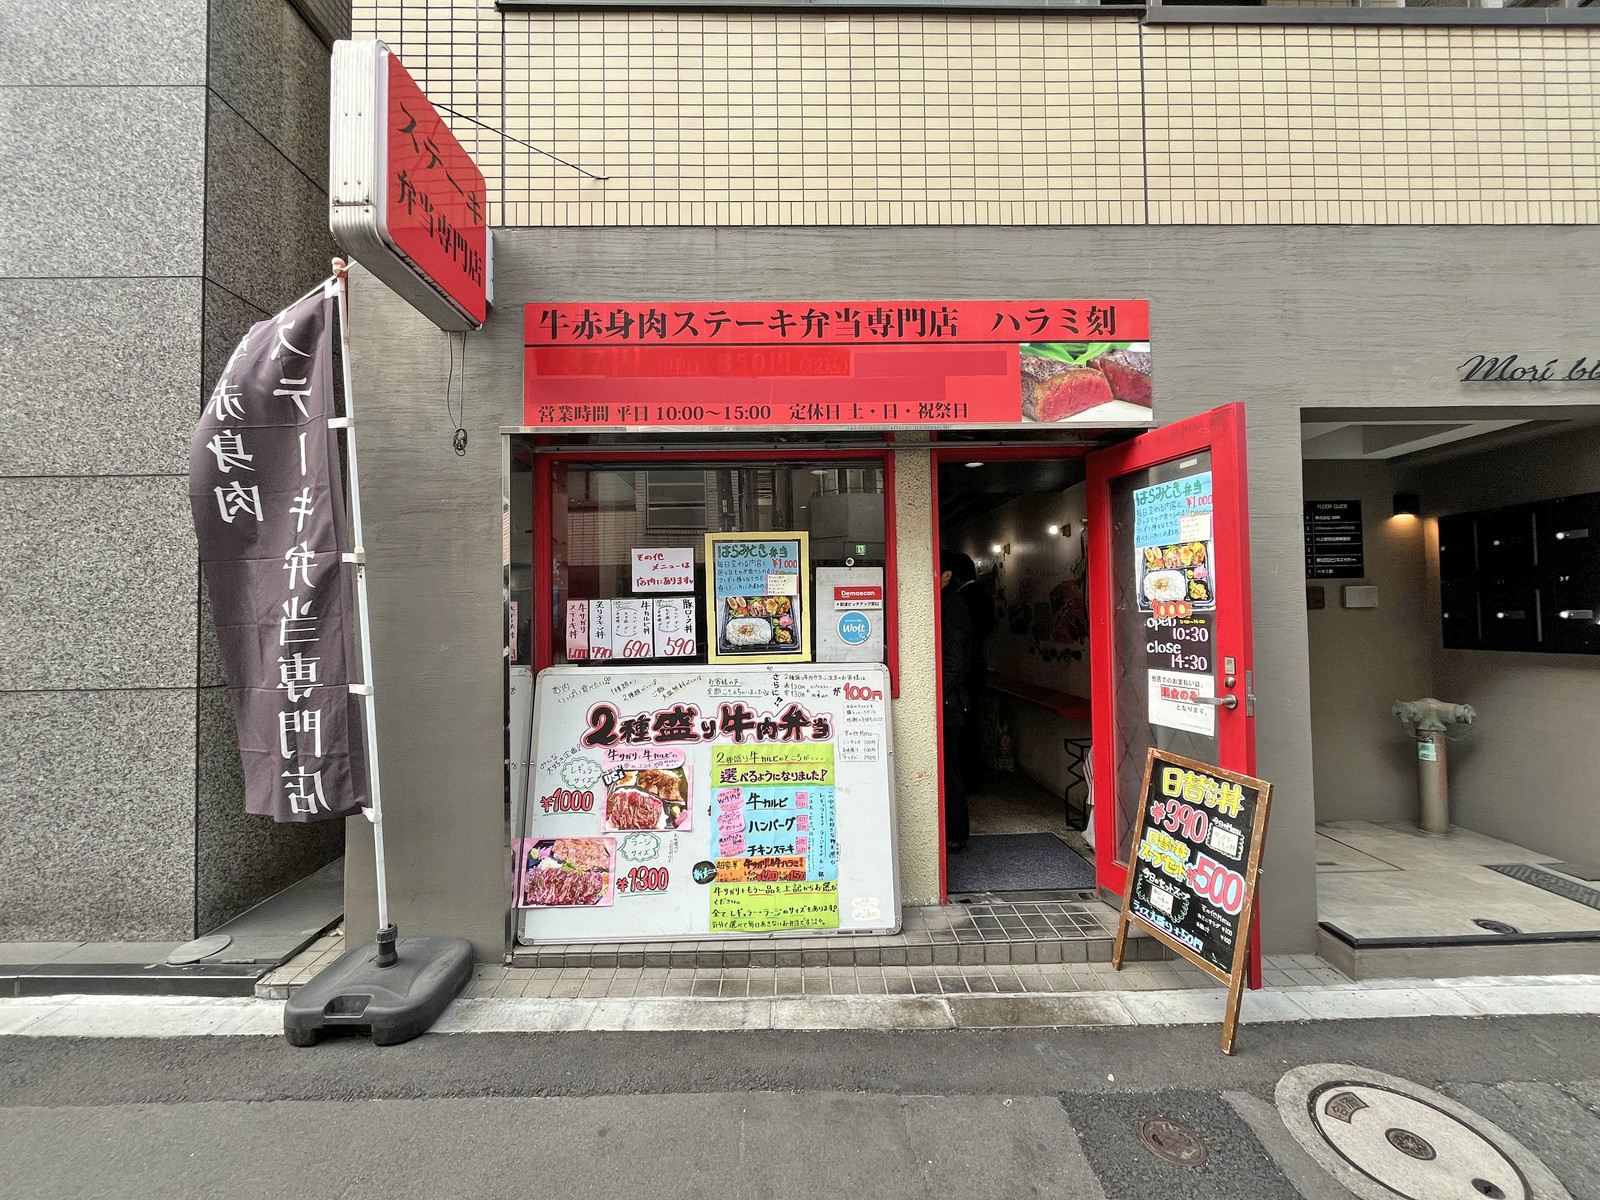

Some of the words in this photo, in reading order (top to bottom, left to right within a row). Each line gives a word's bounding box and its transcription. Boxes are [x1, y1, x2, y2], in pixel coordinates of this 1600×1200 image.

[538, 307, 959, 340] 牛赤身肉ステーキ弁当専門店
[990, 305, 1117, 336] ハラミ刻
[538, 405, 610, 423] 営業時間
[616, 405, 649, 422] 平日
[789, 404, 840, 421] 定休日
[1136, 480, 1202, 506] はらみとき弁当
[637, 553, 665, 561] その他
[717, 543, 788, 559] はらみとき弁当
[652, 562, 691, 571] メニューは
[841, 590, 876, 598] Demaecan
[682, 598, 693, 633] 豚ロース丼
[843, 623, 865, 633] Wolt
[1172, 626, 1209, 642] 10:30
[664, 636, 695, 656] 590
[1146, 640, 1182, 654] close
[1171, 653, 1208, 671] 14:30
[843, 682, 882, 700] 100円
[586, 705, 830, 747] 2種盛り牛肉弁当
[570, 764, 598, 774] レギュラー
[574, 776, 593, 784] サイズ
[540, 788, 595, 813] ¥1000
[746, 792, 788, 810] 牛カルビ
[749, 816, 796, 833] ハンバーグ
[1150, 799, 1209, 843] ¥390
[747, 843, 795, 857] チキンステーキ
[616, 866, 669, 893] ¥1300
[1187, 855, 1245, 914] ¥500
